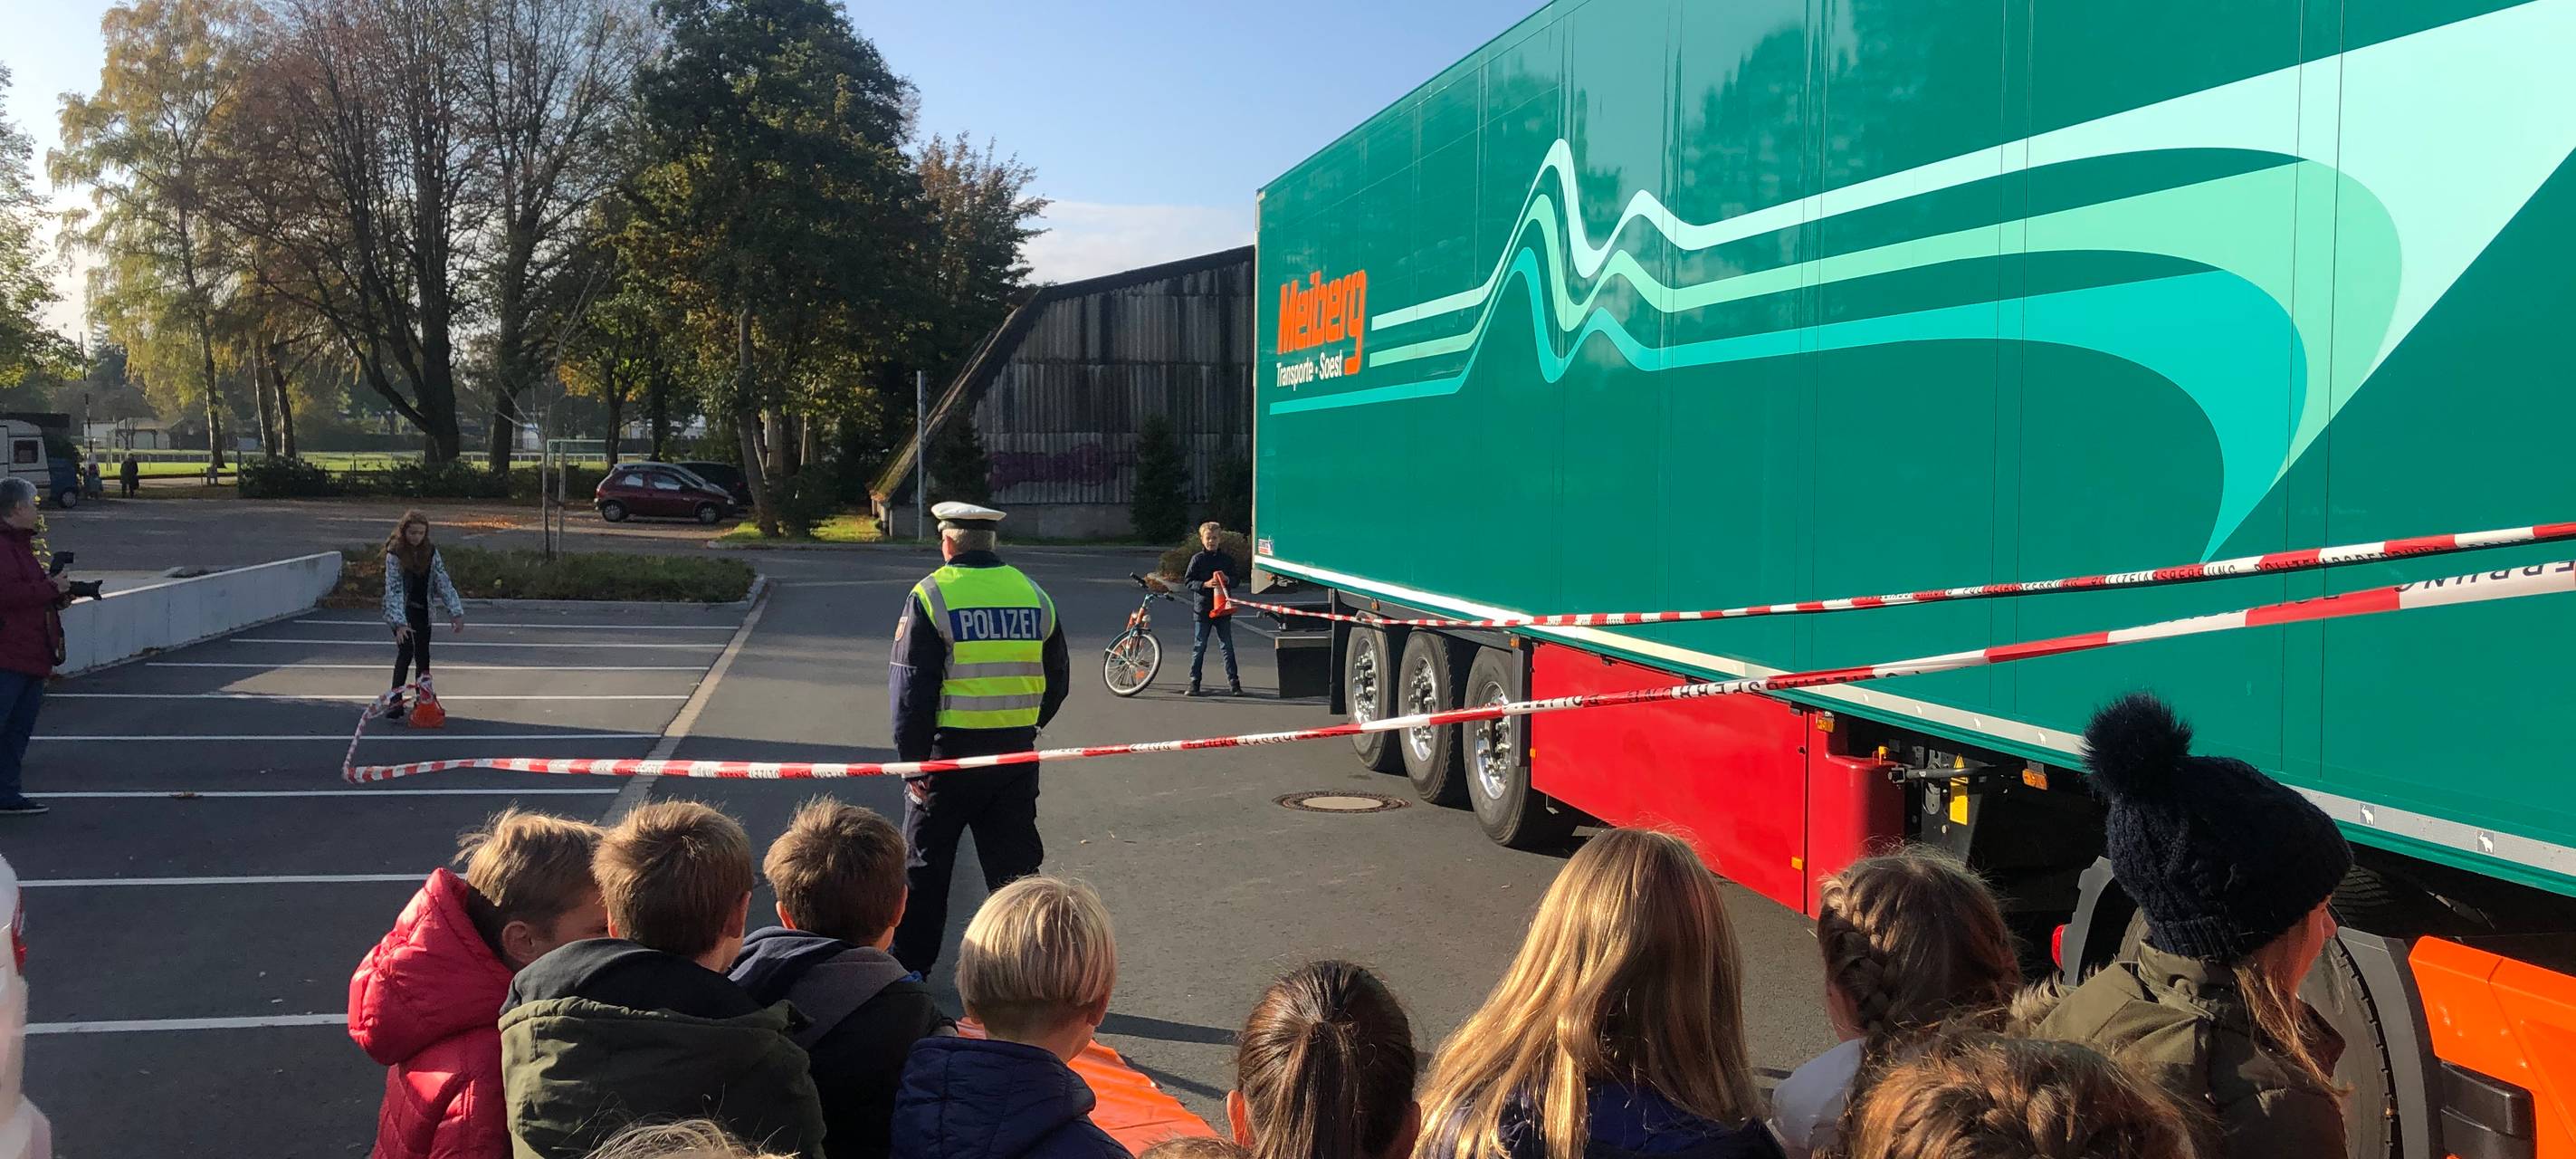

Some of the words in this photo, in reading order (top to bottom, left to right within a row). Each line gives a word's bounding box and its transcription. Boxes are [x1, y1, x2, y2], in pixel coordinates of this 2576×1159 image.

[1277, 269, 1367, 376] Meiberg
[1276, 356, 1314, 391] Transporte
[1319, 349, 1343, 380] Soest
[959, 608, 1036, 640] POLIZEI
